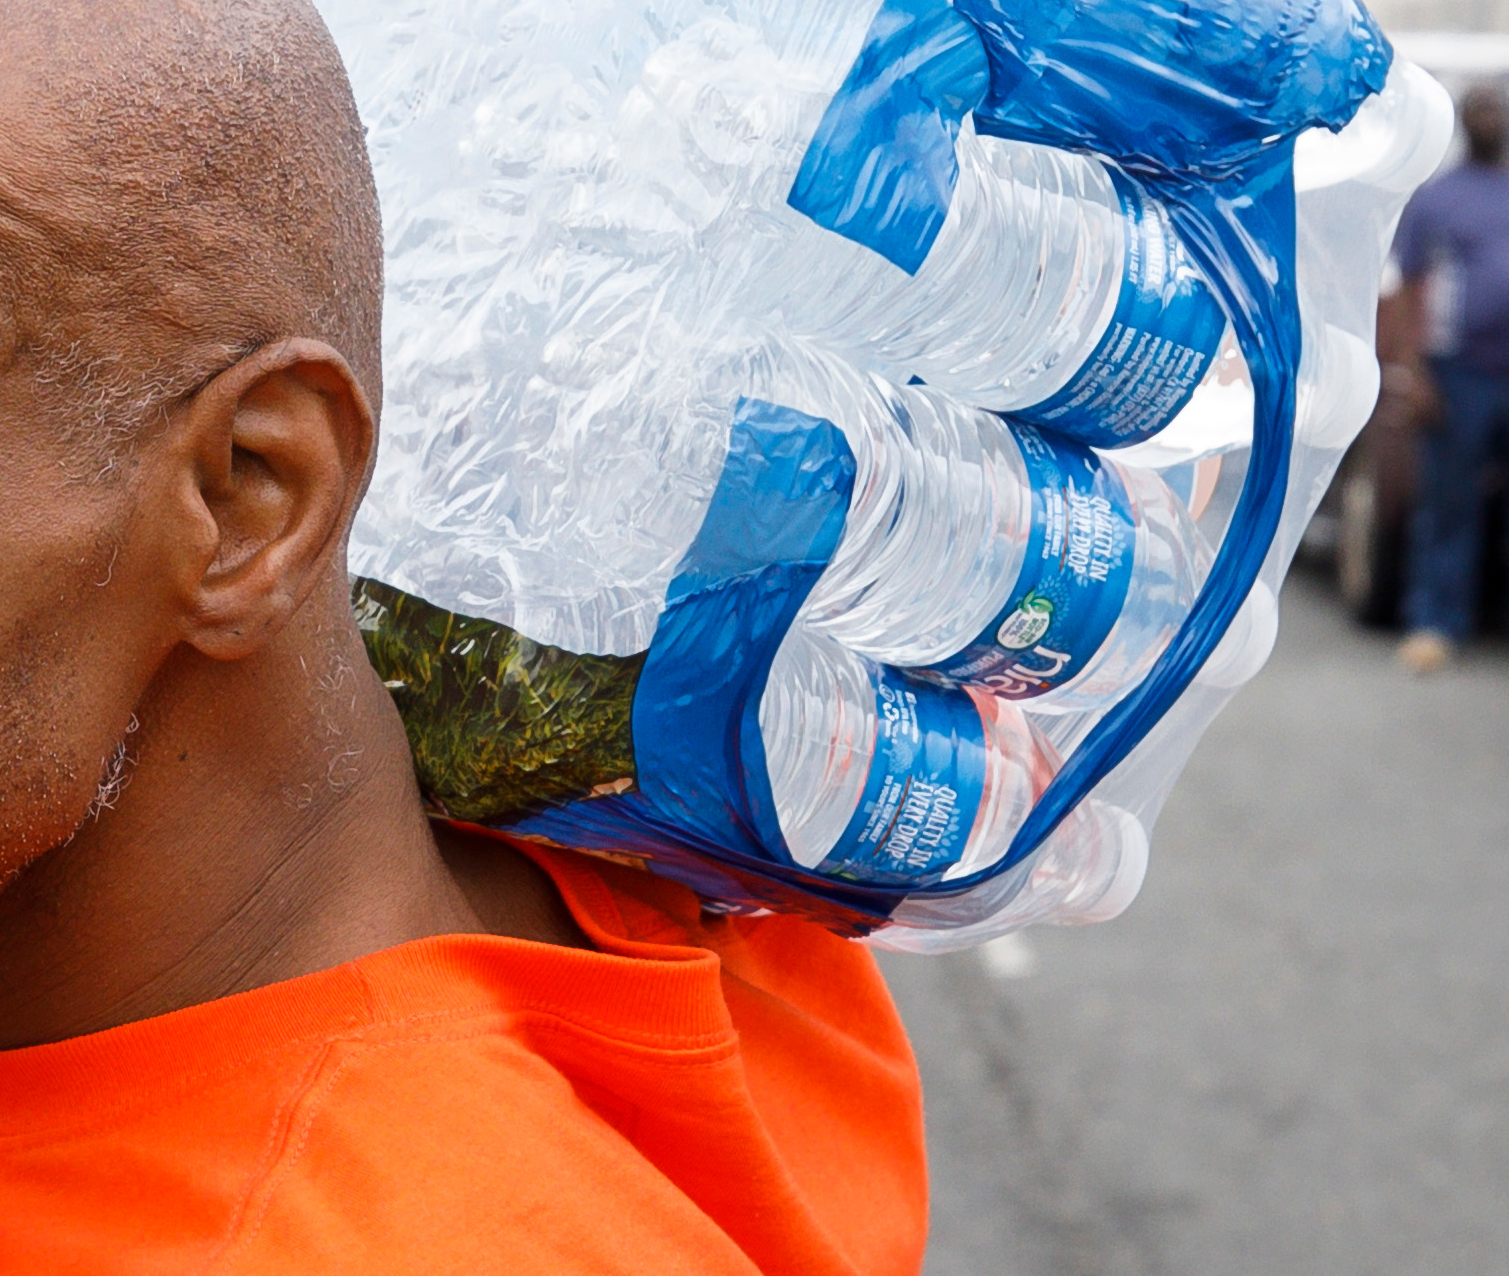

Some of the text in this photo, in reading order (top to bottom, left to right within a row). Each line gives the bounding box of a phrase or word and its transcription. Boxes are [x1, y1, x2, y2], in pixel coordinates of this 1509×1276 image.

[1145, 237, 1164, 285] WATER
[1068, 490, 1092, 574] EVERY DROP
[1089, 496, 1113, 583] QUALITY IN
[970, 644, 1073, 695] nia
[884, 780, 934, 860] EVERY DROP
[906, 785, 958, 869] QUALITY IN
